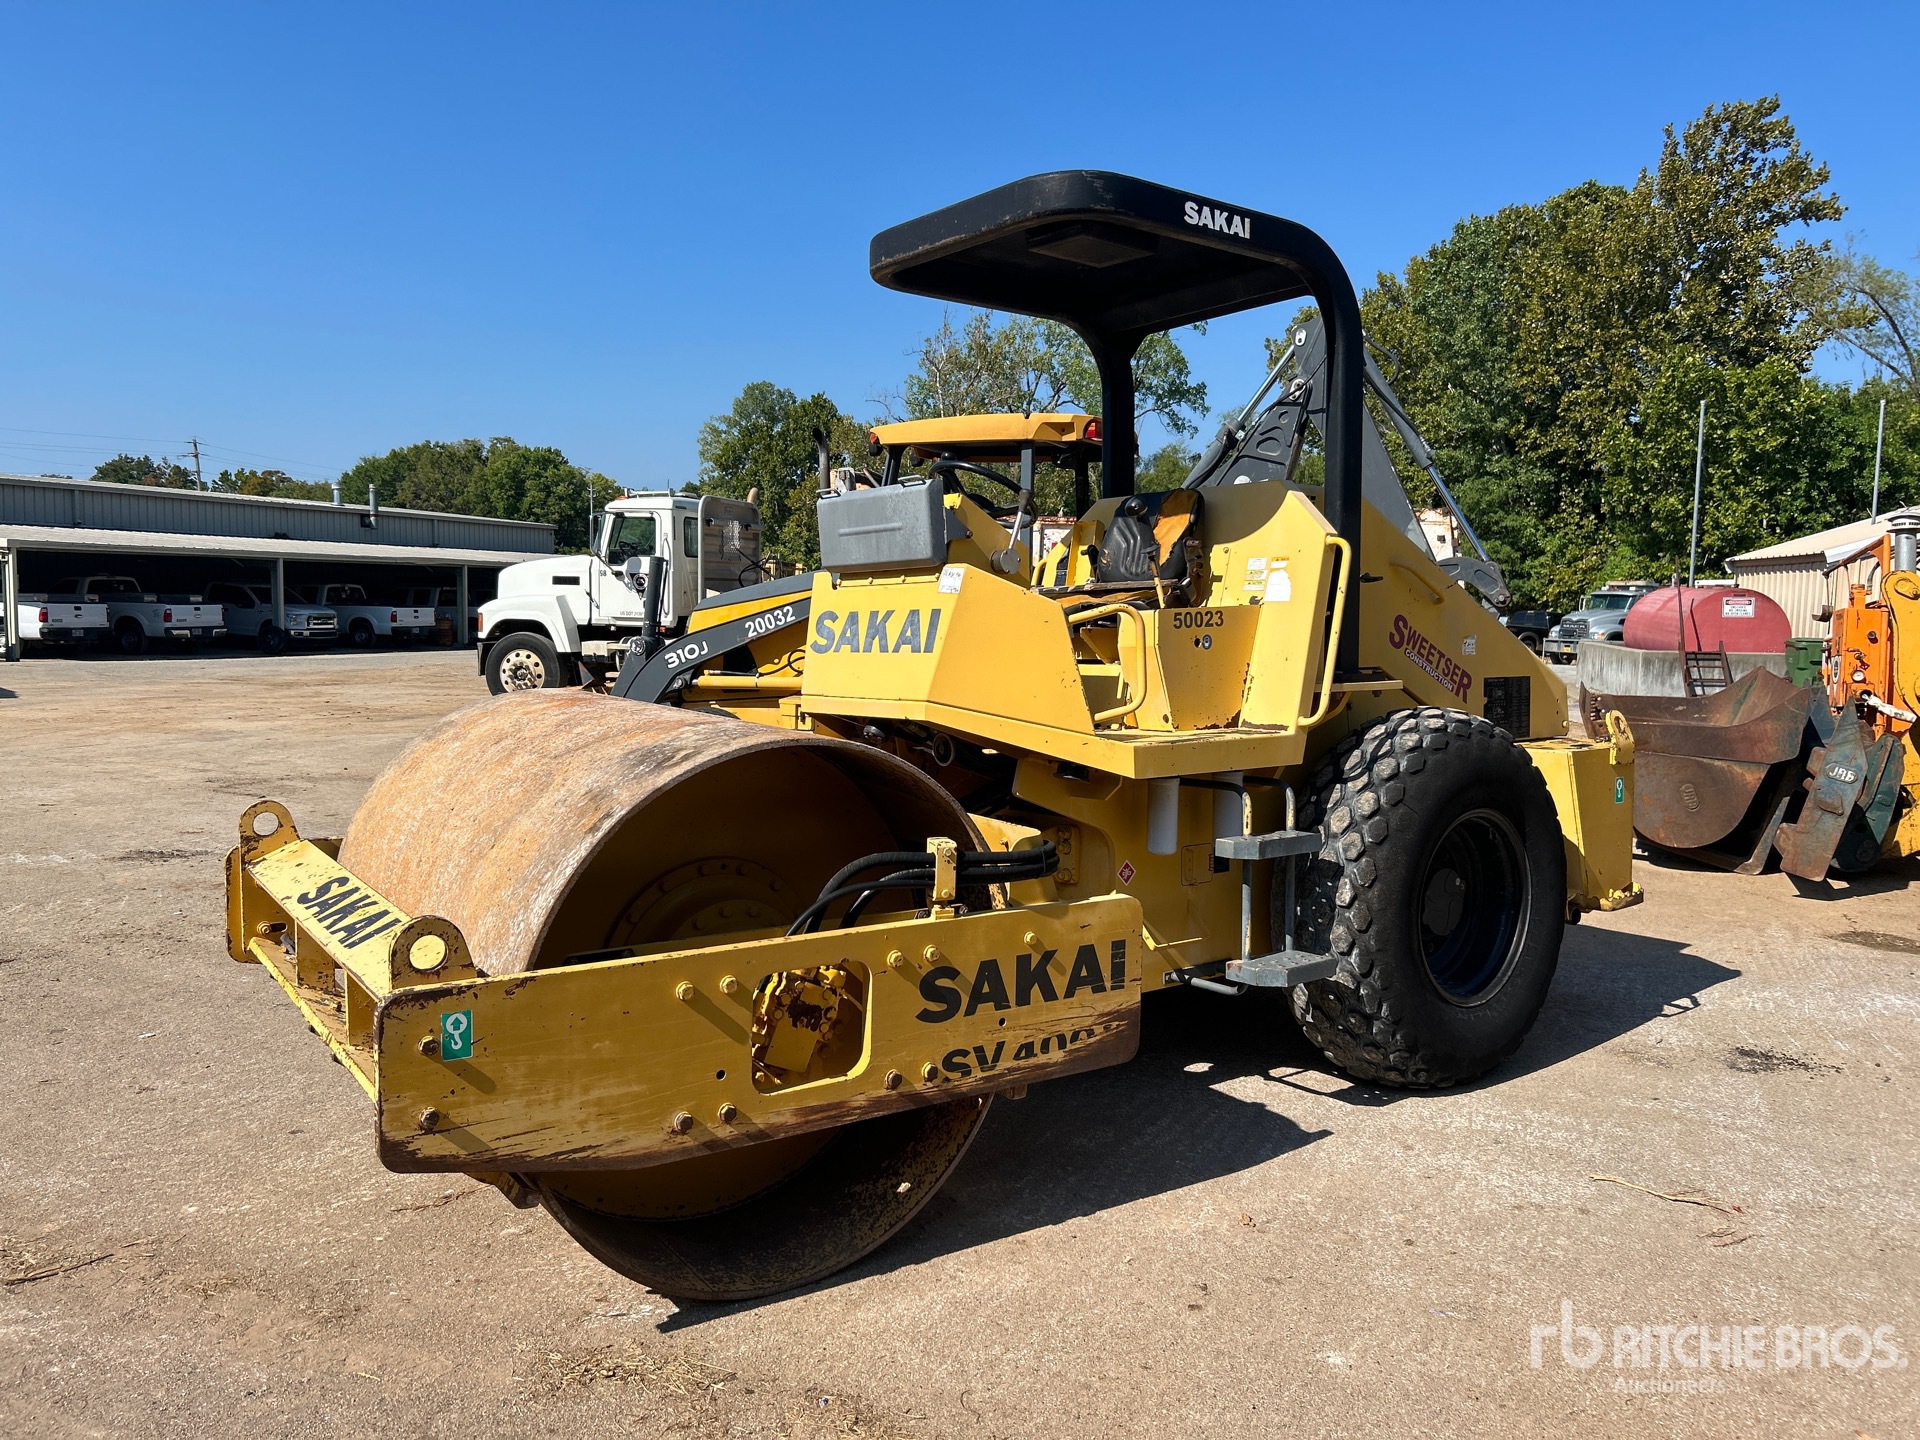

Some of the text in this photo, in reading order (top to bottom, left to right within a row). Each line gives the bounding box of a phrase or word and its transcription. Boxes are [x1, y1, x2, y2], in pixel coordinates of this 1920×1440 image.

[1184, 201, 1250, 239] SAKAI
[744, 606, 796, 638] 20032
[810, 608, 942, 654] SAKAI
[1173, 610, 1224, 630] 50023
[664, 640, 709, 669] 310J
[1389, 614, 1473, 704] SWEETSER
[1405, 649, 1454, 691] CONSTRUCTION
[297, 876, 402, 949] SAKAI
[915, 939, 1127, 1024] SAKAI
